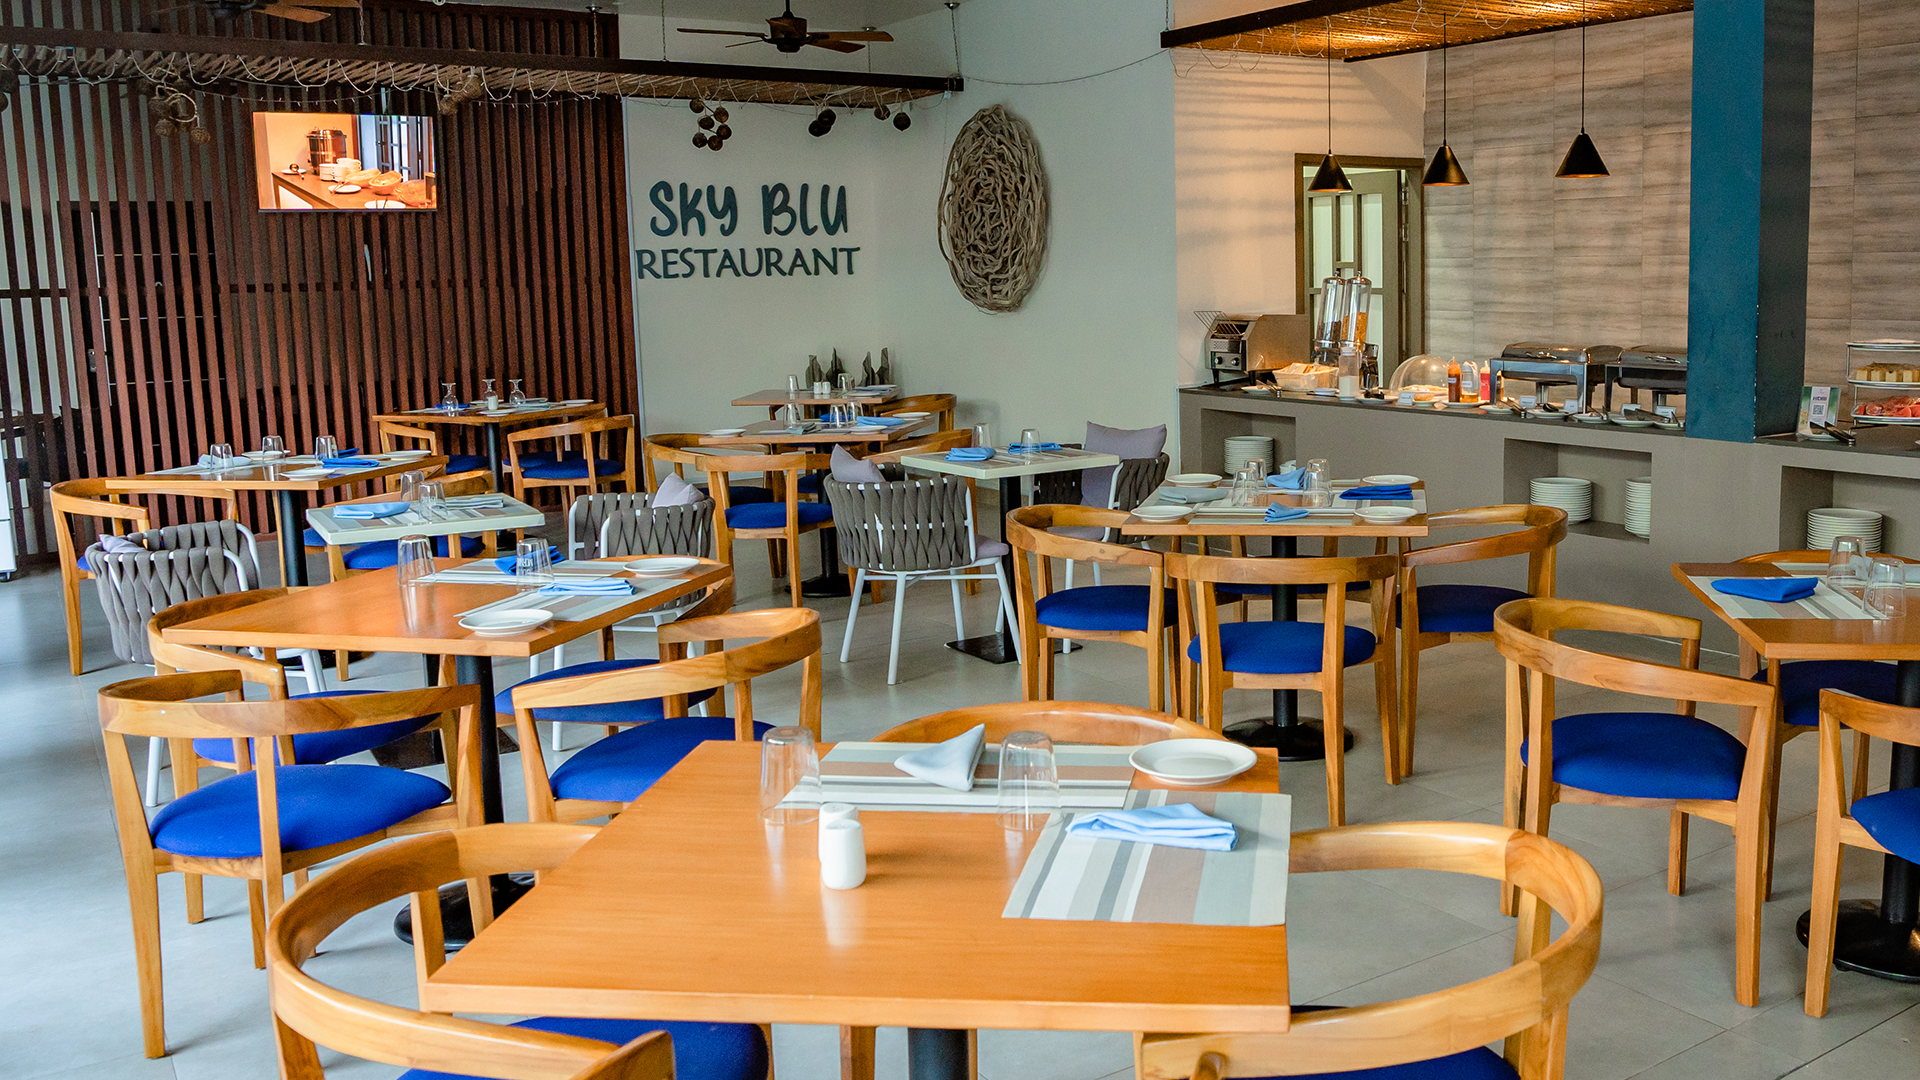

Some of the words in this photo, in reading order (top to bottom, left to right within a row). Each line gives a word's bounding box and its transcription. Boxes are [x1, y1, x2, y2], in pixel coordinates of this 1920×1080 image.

[649, 180, 739, 237] SKY
[761, 182, 848, 236] BLU
[634, 246, 861, 280] RESTAURANT
